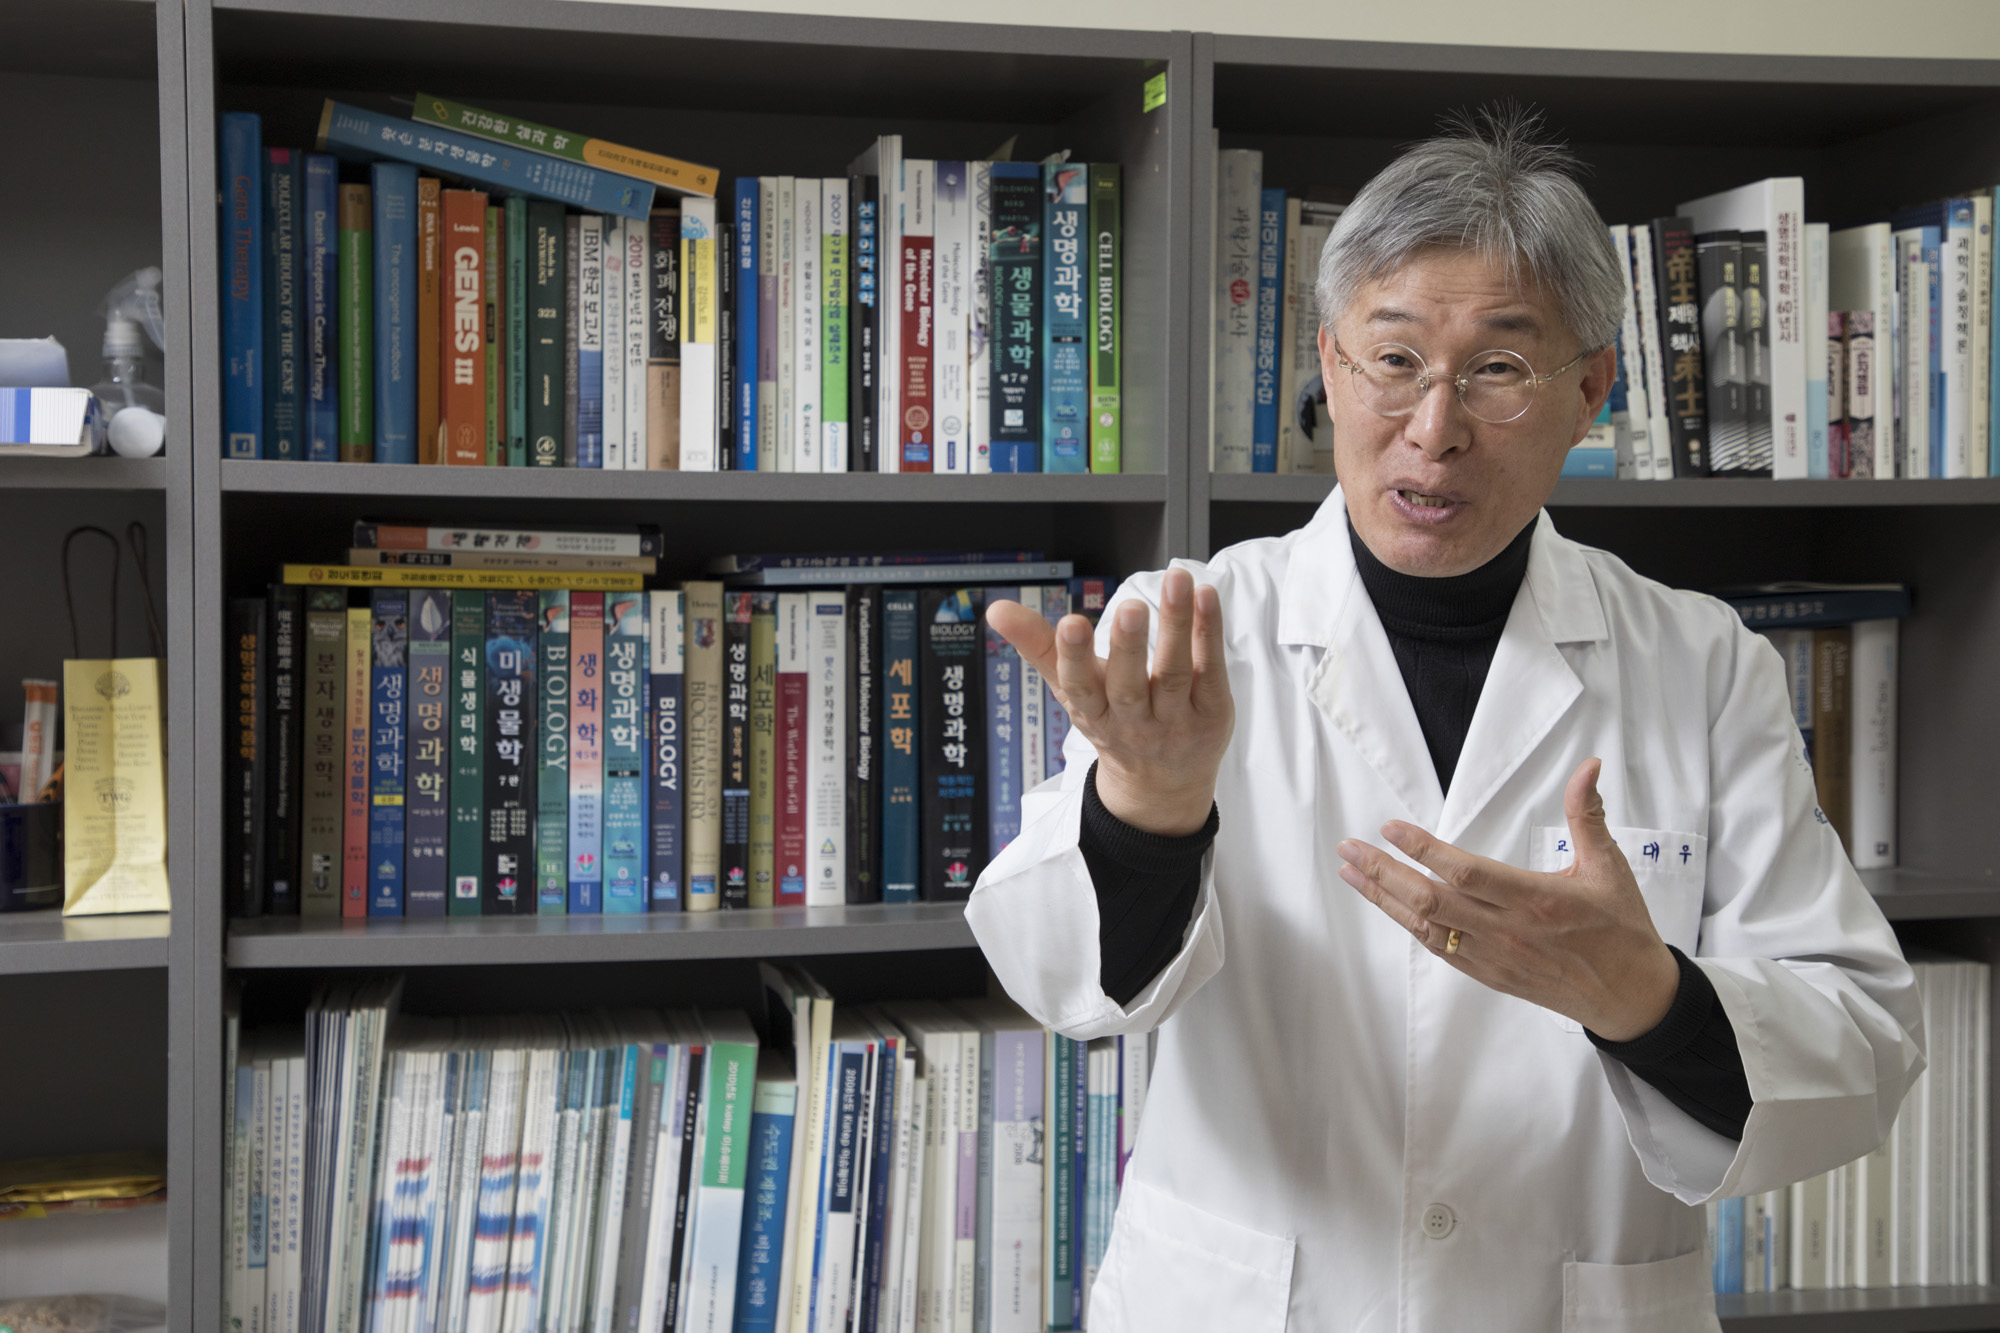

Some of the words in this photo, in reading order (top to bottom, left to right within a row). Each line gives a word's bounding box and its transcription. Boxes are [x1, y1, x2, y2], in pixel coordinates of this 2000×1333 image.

[416, 135, 497, 170] 분자생물학
[233, 175, 251, 222] Gene
[279, 173, 293, 250] MOLECULAR
[831, 194, 841, 226] 2007
[314, 210, 326, 245] Death
[425, 212, 435, 234] RNA
[454, 223, 480, 233] Lewin
[231, 228, 251, 302] Therapy
[391, 244, 402, 264] The
[425, 236, 435, 271] Viruses
[584, 228, 598, 262] IBM
[629, 234, 642, 268] 2010
[905, 248, 917, 259] of
[942, 254, 949, 264] of
[952, 242, 961, 283] Molecular
[1052, 210, 1082, 320] 생명과학
[1098, 231, 1113, 273] CELL
[1777, 212, 1791, 296] 생명과학대학
[280, 253, 294, 311] BIOLOGY
[312, 247, 326, 300] Receptors
[512, 258, 525, 303] Apoptosis
[583, 267, 599, 295] 한국
[905, 262, 917, 281] the
[919, 249, 931, 304] Molecular
[314, 303, 326, 315] in
[389, 268, 401, 323] oncogene
[454, 247, 480, 353] GENES
[513, 307, 523, 316] in
[629, 273, 642, 326] 대한민국
[829, 269, 842, 319] 모바일산업
[905, 283, 917, 312] Gene
[950, 285, 961, 316] Biology
[1098, 276, 1113, 354] BIOLOGY
[1957, 237, 1969, 354] 과학기술정책론
[281, 312, 294, 327] OF
[314, 316, 326, 355] Cancer
[513, 320, 524, 350] Health
[583, 300, 599, 345] 보고서
[917, 306, 931, 347] Biology
[1008, 266, 1034, 370] 생물과학
[281, 330, 294, 357] THE
[391, 326, 402, 382] handbook
[513, 355, 523, 372] and
[630, 332, 642, 368] 트렌드
[281, 360, 295, 394] GENE
[311, 356, 326, 400] Therapy
[454, 358, 474, 385] III
[513, 376, 524, 411] Disease
[456, 450, 477, 459] Wiley
[887, 602, 914, 611] CELLS
[859, 598, 872, 674] Fundamental
[930, 624, 976, 635] BIOLOGY
[460, 646, 477, 755] 식물생리학
[576, 653, 598, 747] 생화학
[609, 642, 640, 752] 생명과학
[729, 643, 748, 722] 생명과학
[994, 662, 1013, 742] 생명과학
[313, 652, 336, 783] 분자생물학
[376, 673, 404, 777] 생명과학
[496, 649, 523, 766] 미생물학
[546, 645, 568, 772] BIOLOGY
[786, 705, 799, 727] The
[859, 676, 872, 733] Molecular
[889, 658, 914, 755] 세포학
[942, 665, 968, 769] 생명과학
[415, 665, 446, 802] 생명과학
[659, 697, 677, 790] BIOLOGY
[690, 681, 706, 824] BIOCHEMISTRY
[708, 683, 718, 790] PRINCIPLES
[786, 728, 799, 759] World
[351, 728, 366, 806] 분자생물학
[786, 761, 799, 772] of
[857, 736, 872, 781] Biology
[786, 775, 799, 791] the
[786, 793, 799, 814] Cell
[708, 801, 718, 818] OF
[726, 1059, 739, 1101] 2010년도
[843, 1068, 857, 1113] 2008년도
